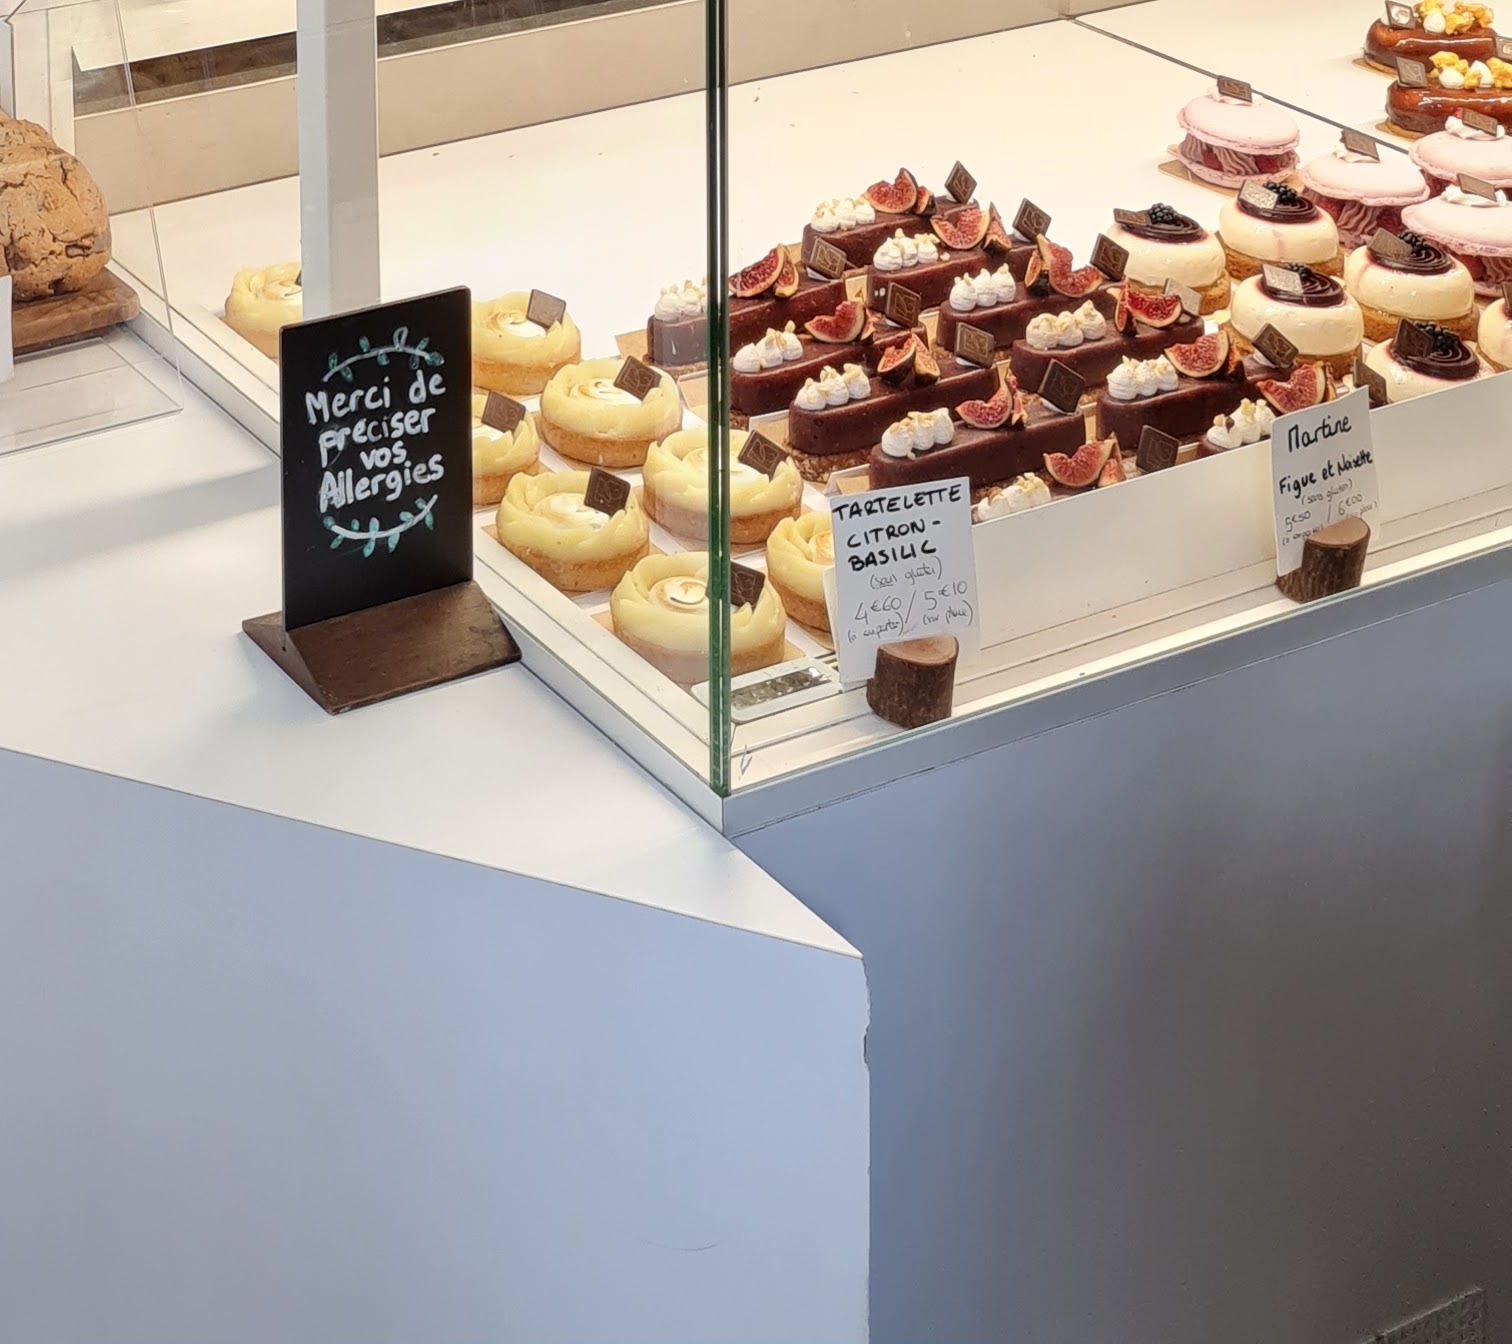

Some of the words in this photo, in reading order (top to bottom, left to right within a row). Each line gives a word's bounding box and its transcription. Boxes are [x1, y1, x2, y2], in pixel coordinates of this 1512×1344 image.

[305, 375, 390, 425] Merci
[409, 369, 446, 404] de
[1288, 415, 1352, 452] Martine
[360, 440, 408, 470] vos
[319, 453, 445, 513] Allergies
[1279, 471, 1317, 499] Figue
[1322, 460, 1334, 480] et
[833, 484, 962, 521] TARTELETTE
[848, 540, 936, 571] BASILIC
